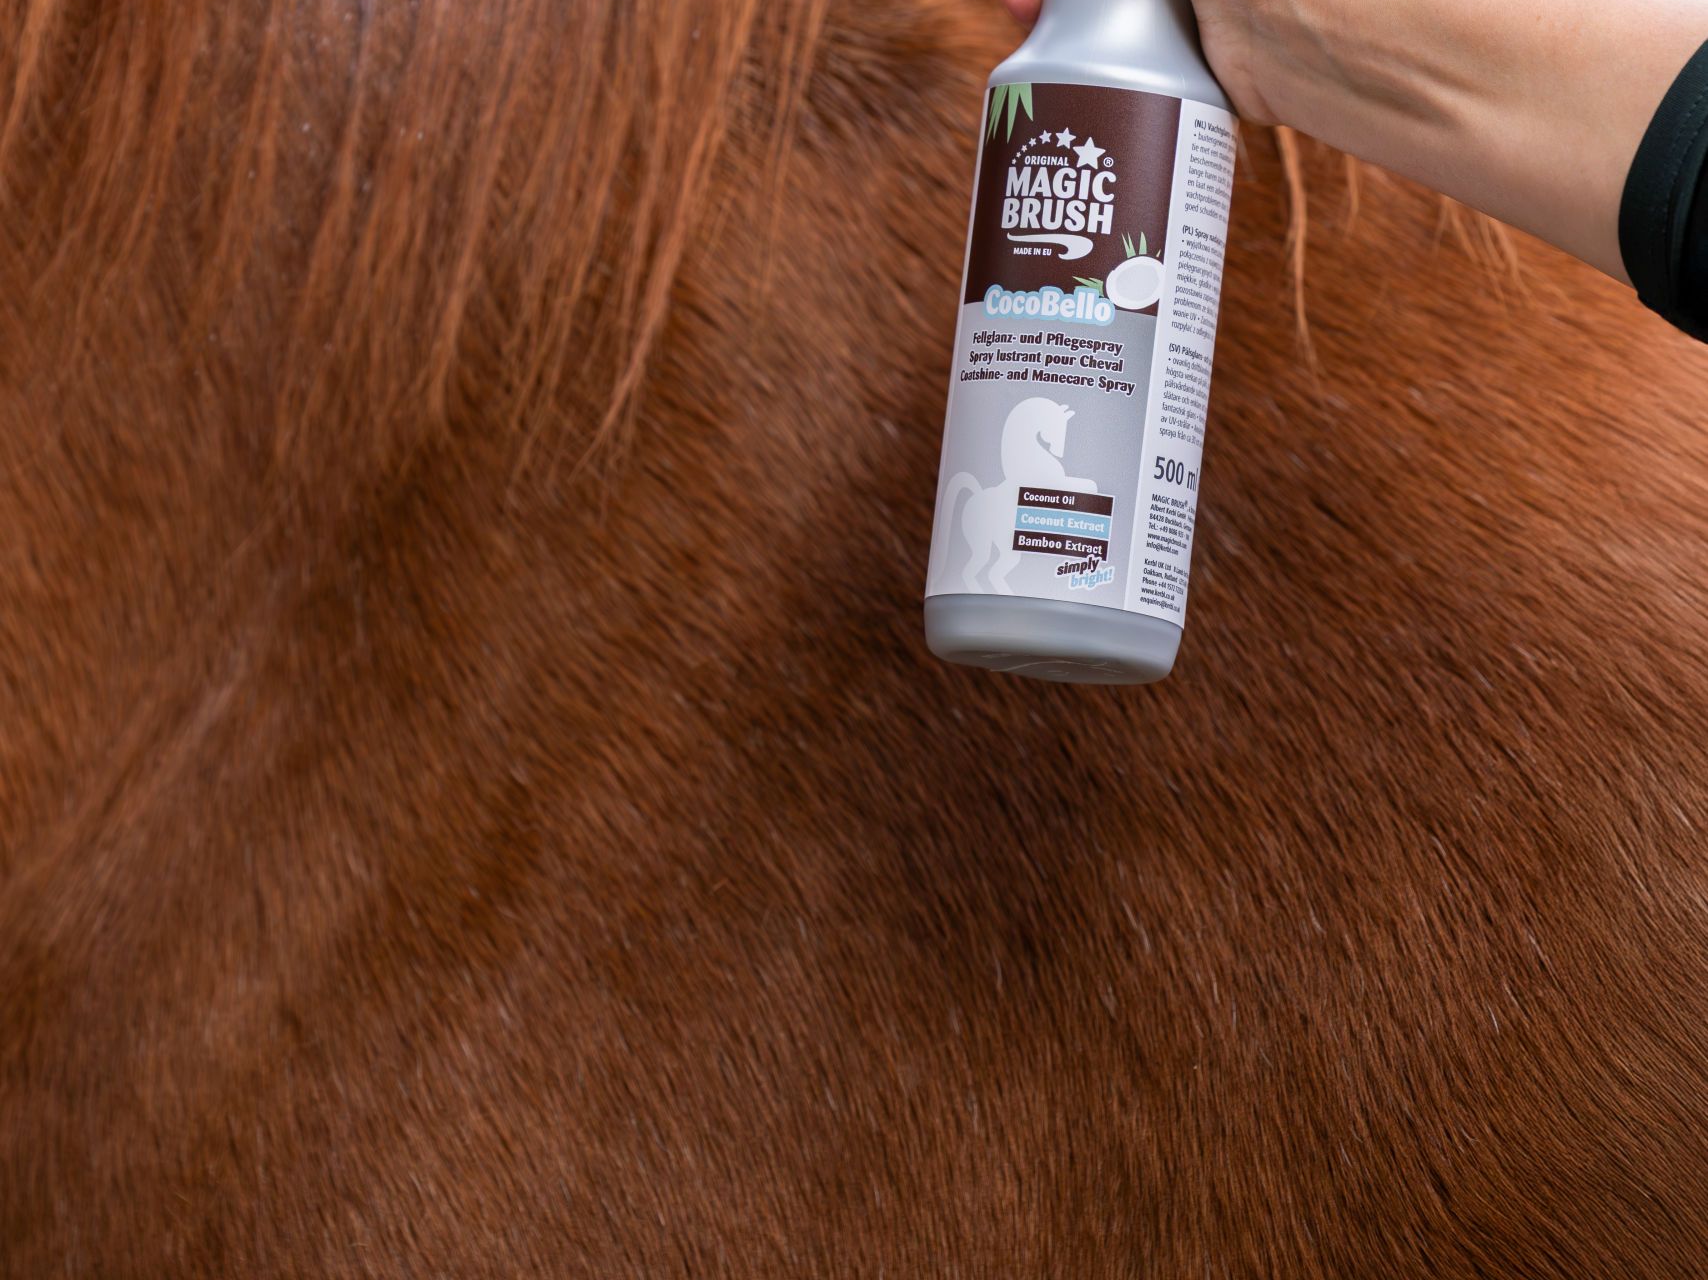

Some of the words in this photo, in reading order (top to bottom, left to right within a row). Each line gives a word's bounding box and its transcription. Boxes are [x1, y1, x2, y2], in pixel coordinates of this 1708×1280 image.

[1024, 155, 1070, 166] ORIGINAL
[1005, 166, 1117, 202] MAGIC
[1001, 197, 1114, 235] BRUSH
[1013, 247, 1033, 255] MADE
[1033, 247, 1042, 255] IN
[1042, 248, 1052, 256] EU
[984, 287, 1112, 322] CocoBello
[972, 331, 1017, 346] Fellglanz-
[1019, 332, 1042, 345] und
[1046, 333, 1124, 356] Pflegespray
[1168, 342, 1181, 355] (SV)
[969, 350, 994, 365] Spray
[996, 349, 1041, 363] lustrant
[1045, 355, 1077, 366] pour
[1079, 355, 1124, 372] Cheval
[960, 369, 1004, 382] Coatshine-
[1006, 368, 1028, 381] and
[1032, 371, 1095, 387] Manecare
[1098, 376, 1135, 396] Spray
[1153, 455, 1185, 486] 500
[1023, 491, 1060, 504] Coconut
[1062, 494, 1075, 505] Oil
[1151, 493, 1170, 505] MAGIC
[1020, 513, 1065, 528] Coconut
[1067, 518, 1105, 533] Extract
[1018, 535, 1062, 549] Bamboo
[1065, 540, 1103, 555] Extract
[1056, 556, 1100, 576] simply
[1070, 568, 1112, 588] bright!
